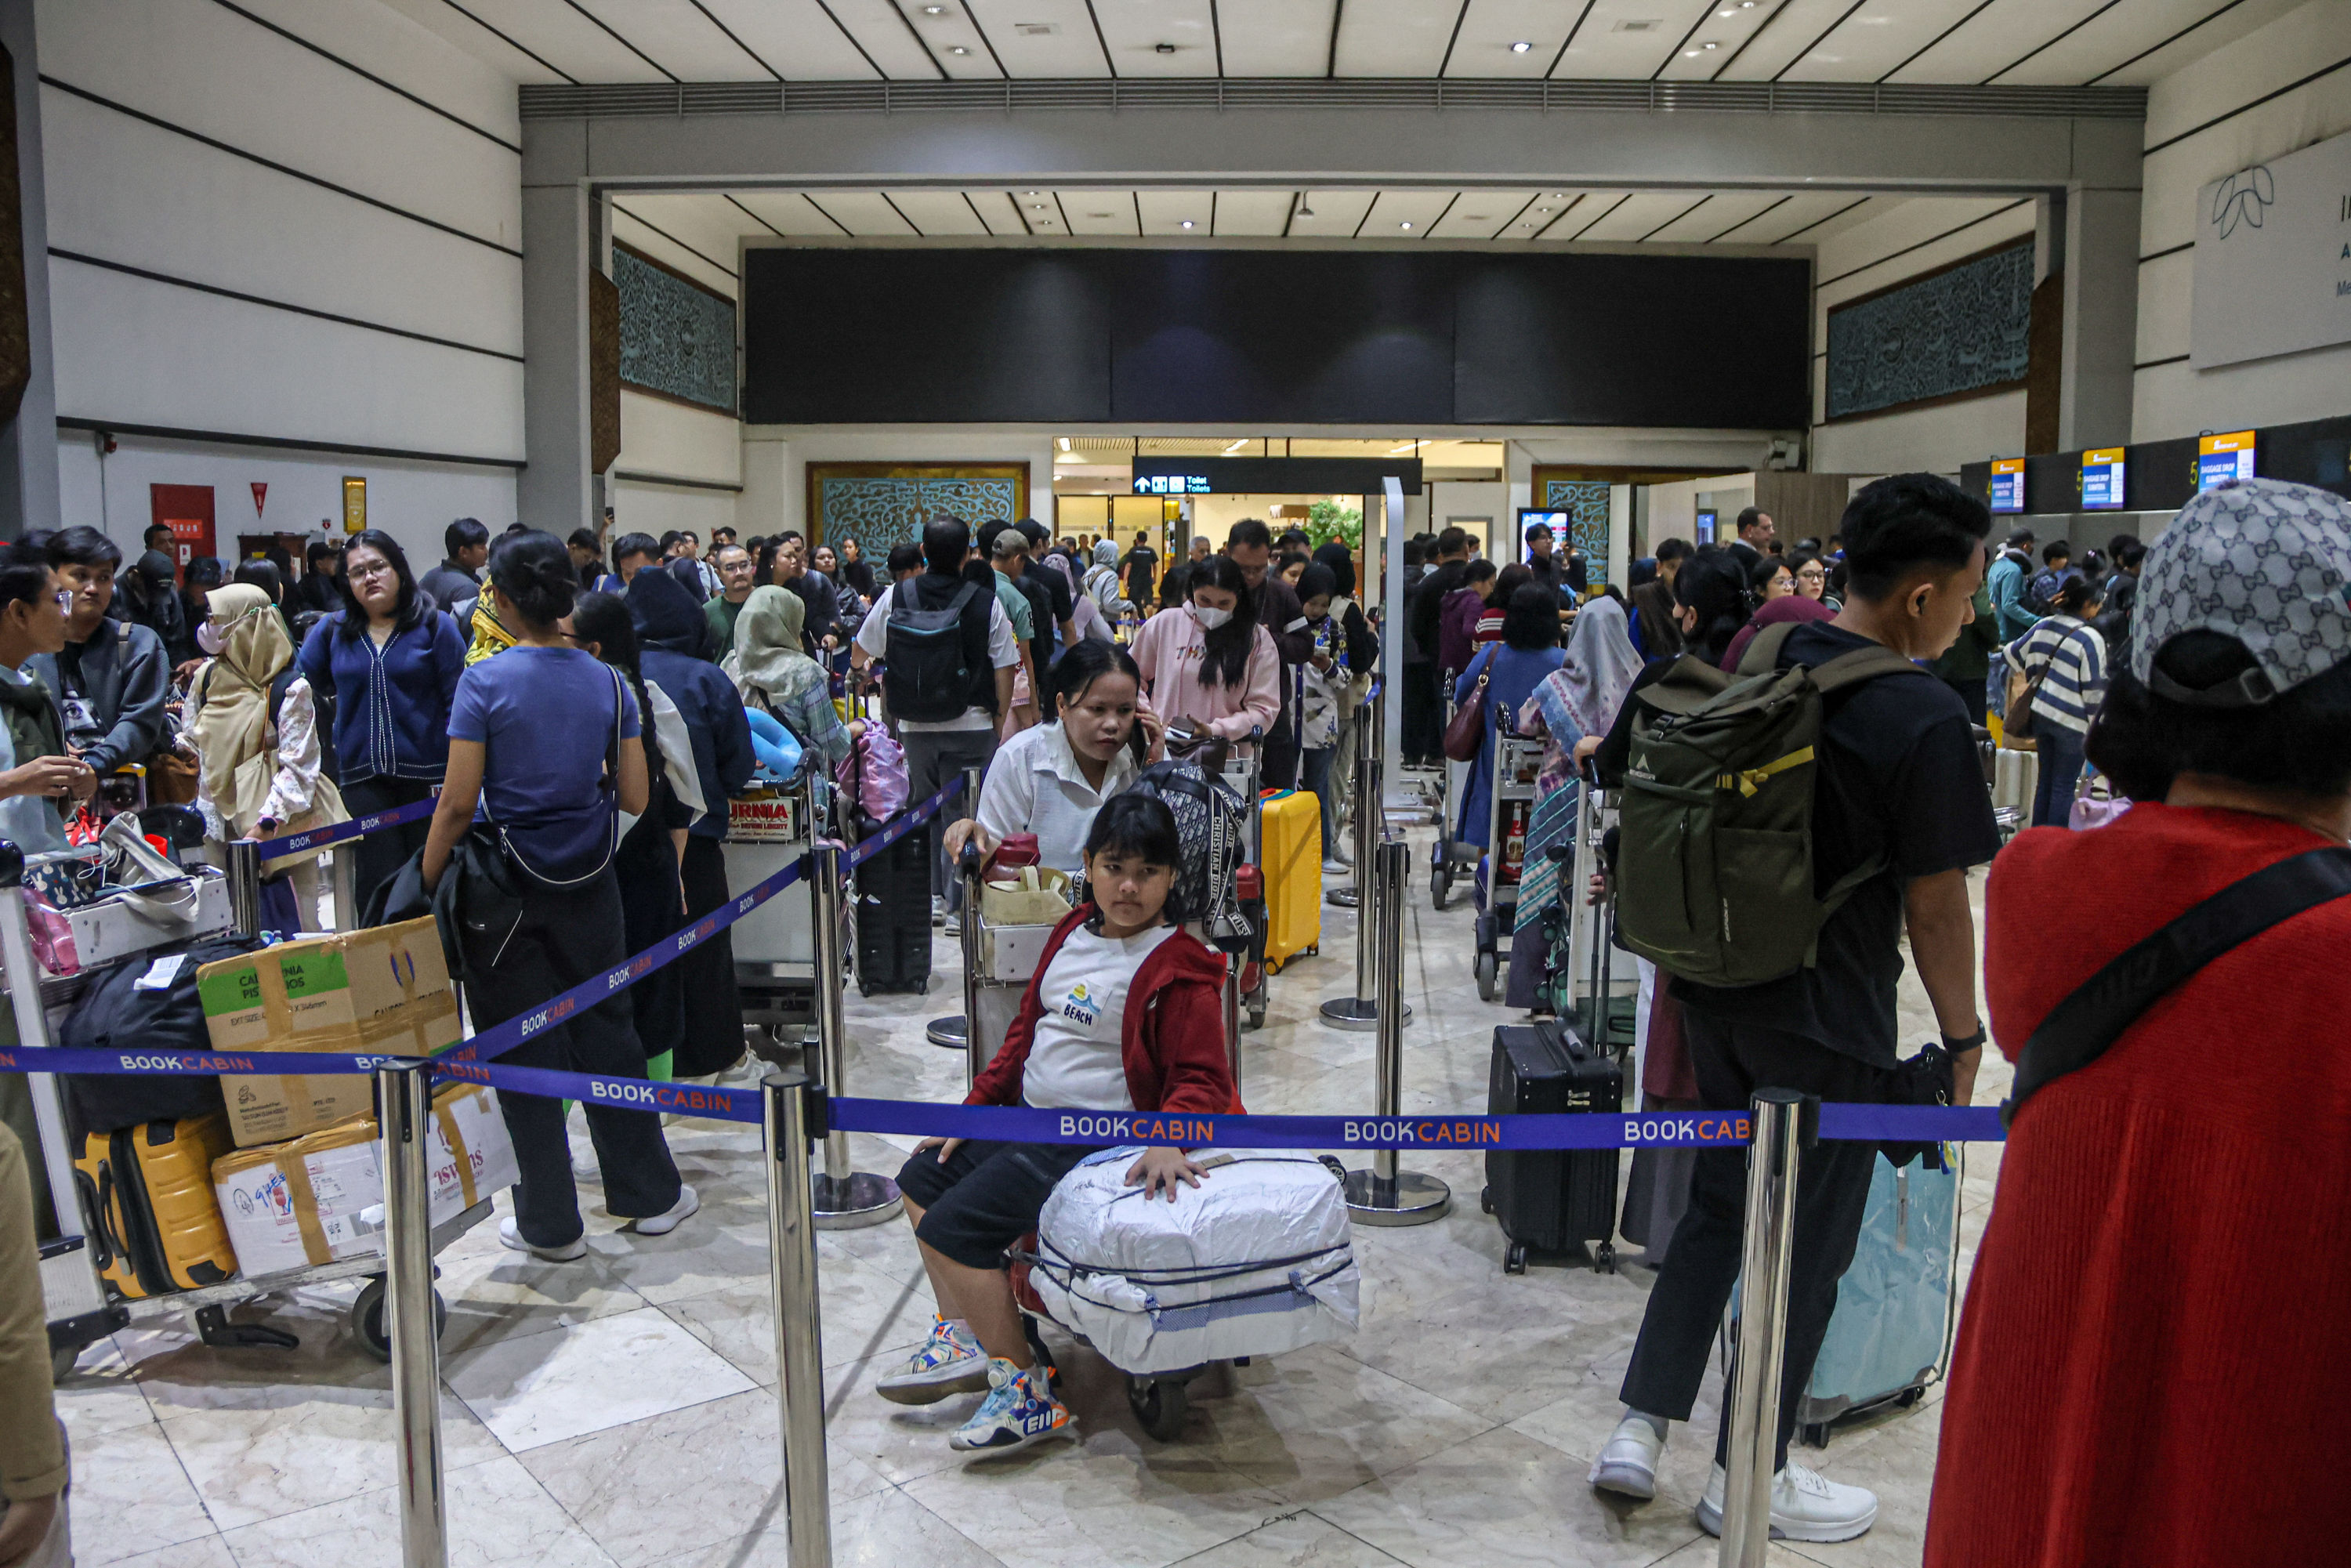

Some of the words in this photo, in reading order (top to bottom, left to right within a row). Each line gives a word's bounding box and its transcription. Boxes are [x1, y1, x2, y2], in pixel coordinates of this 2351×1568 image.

[1186, 476, 1207, 484] Toilet
[289, 829, 334, 849] BOOKCABIN
[678, 918, 715, 950] BOOKCABIN
[609, 955, 652, 989] BOOKCABIN
[521, 998, 574, 1036] BOOKCABIN
[1063, 1004, 1092, 1027] BEACH
[119, 1055, 254, 1070] BOOKCABIN
[591, 1081, 732, 1113] BOOKCABIN
[1060, 1116, 1214, 1142] BOOKCABIN
[1344, 1121, 1500, 1143] BOOKCABIN
[1625, 1119, 1750, 1141] BOOKCAB
